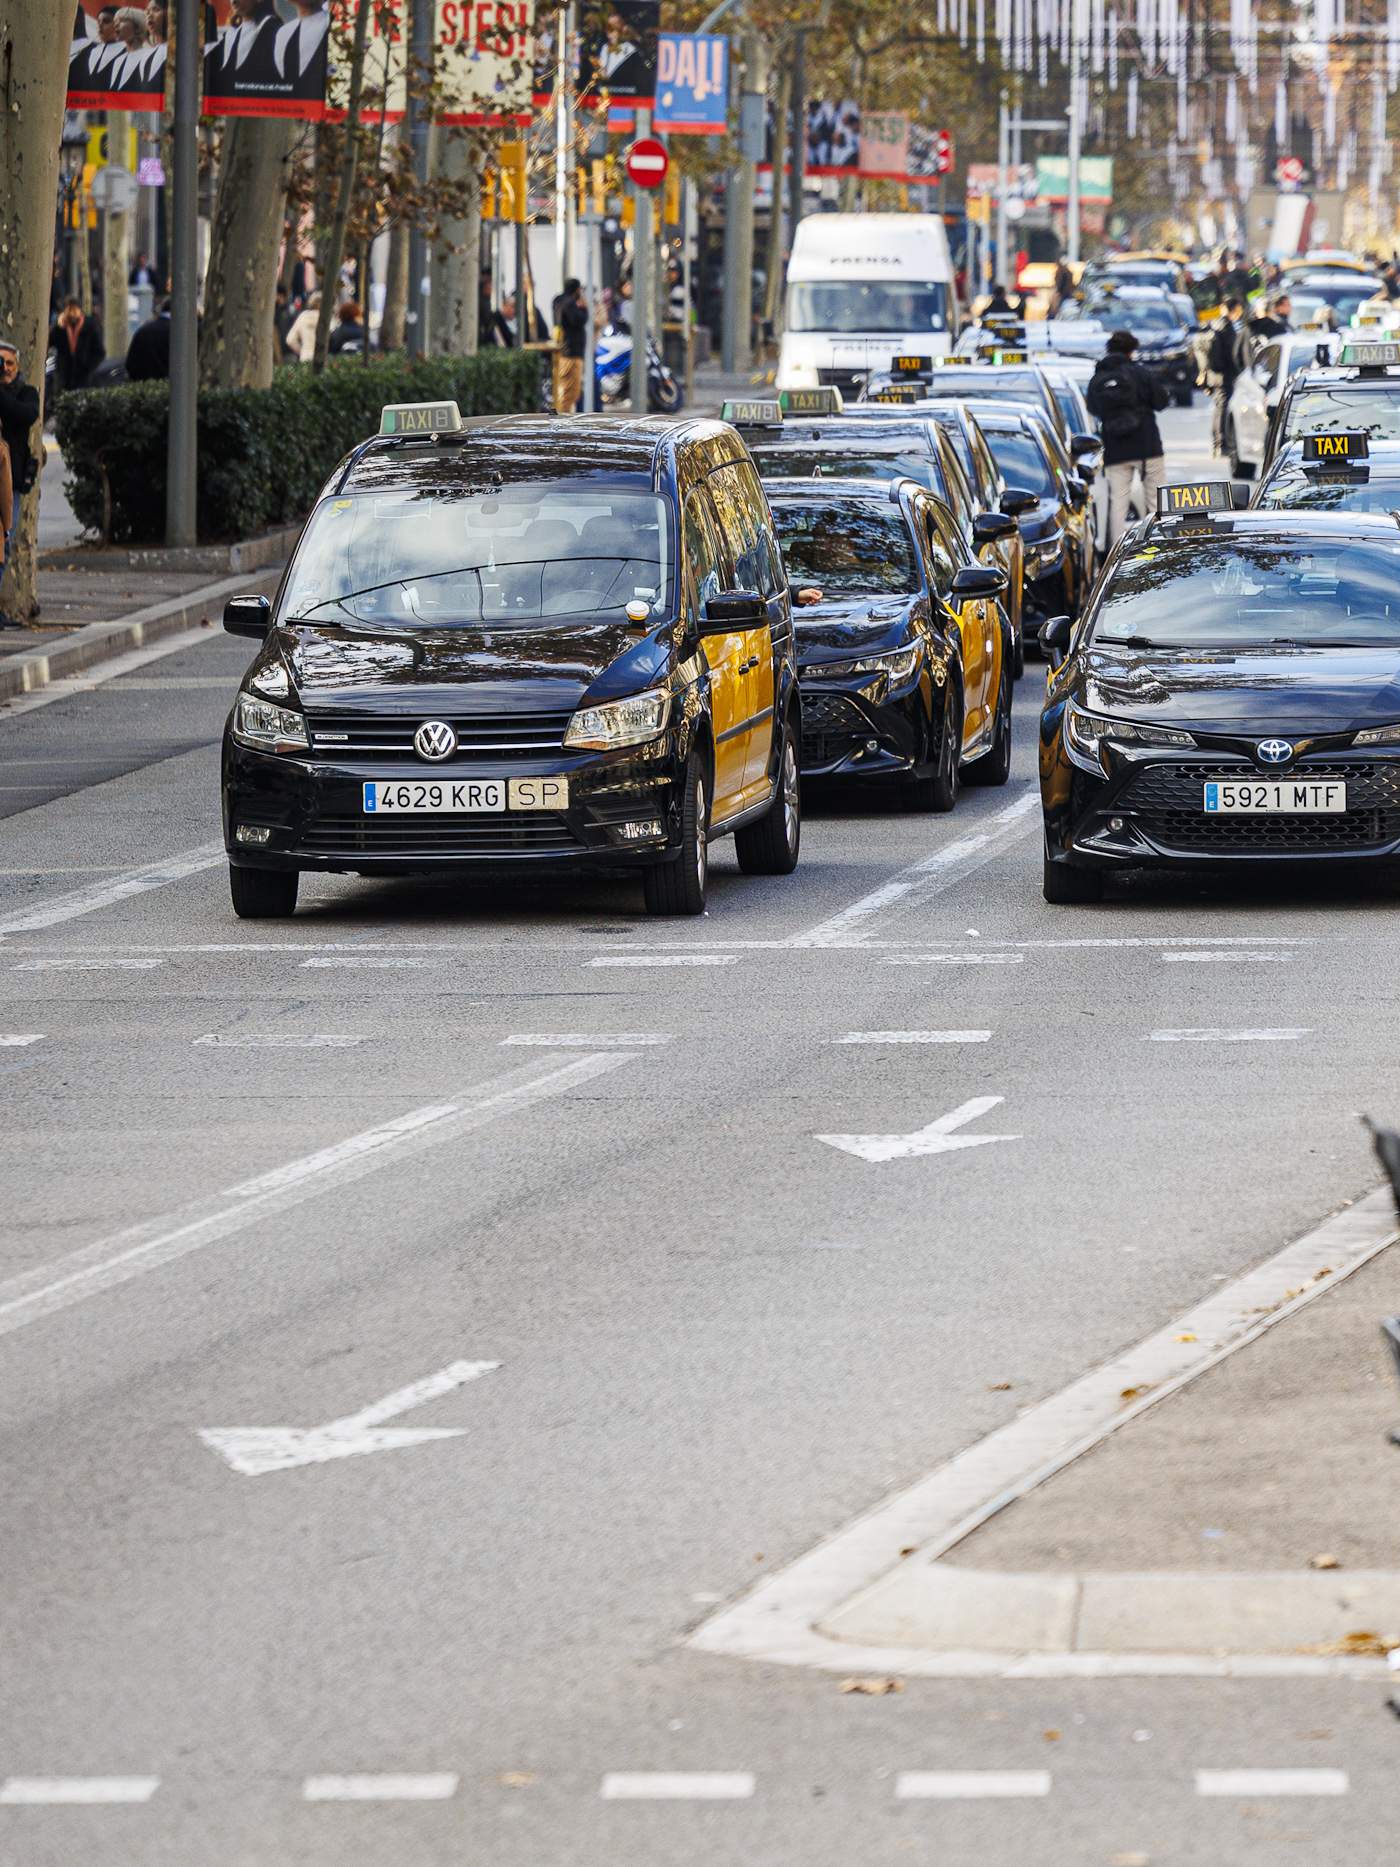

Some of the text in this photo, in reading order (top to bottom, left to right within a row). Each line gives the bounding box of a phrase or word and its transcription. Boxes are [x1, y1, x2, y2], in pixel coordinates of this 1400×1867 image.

[441, 1, 528, 58] STES!
[657, 39, 724, 101] DAL!
[899, 358, 921, 369] TAXI
[1357, 346, 1383, 361] TAXI
[735, 403, 760, 420] TAXI
[792, 393, 820, 410] TAXI
[399, 409, 433, 430] TAXI
[1315, 436, 1349, 456] TAXI
[1170, 486, 1210, 508] TAXI
[381, 786, 442, 808] 4629
[452, 785, 499, 807] KRG
[518, 783, 560, 806] SP
[1222, 786, 1282, 808] 5921
[1294, 786, 1339, 808] MTF
